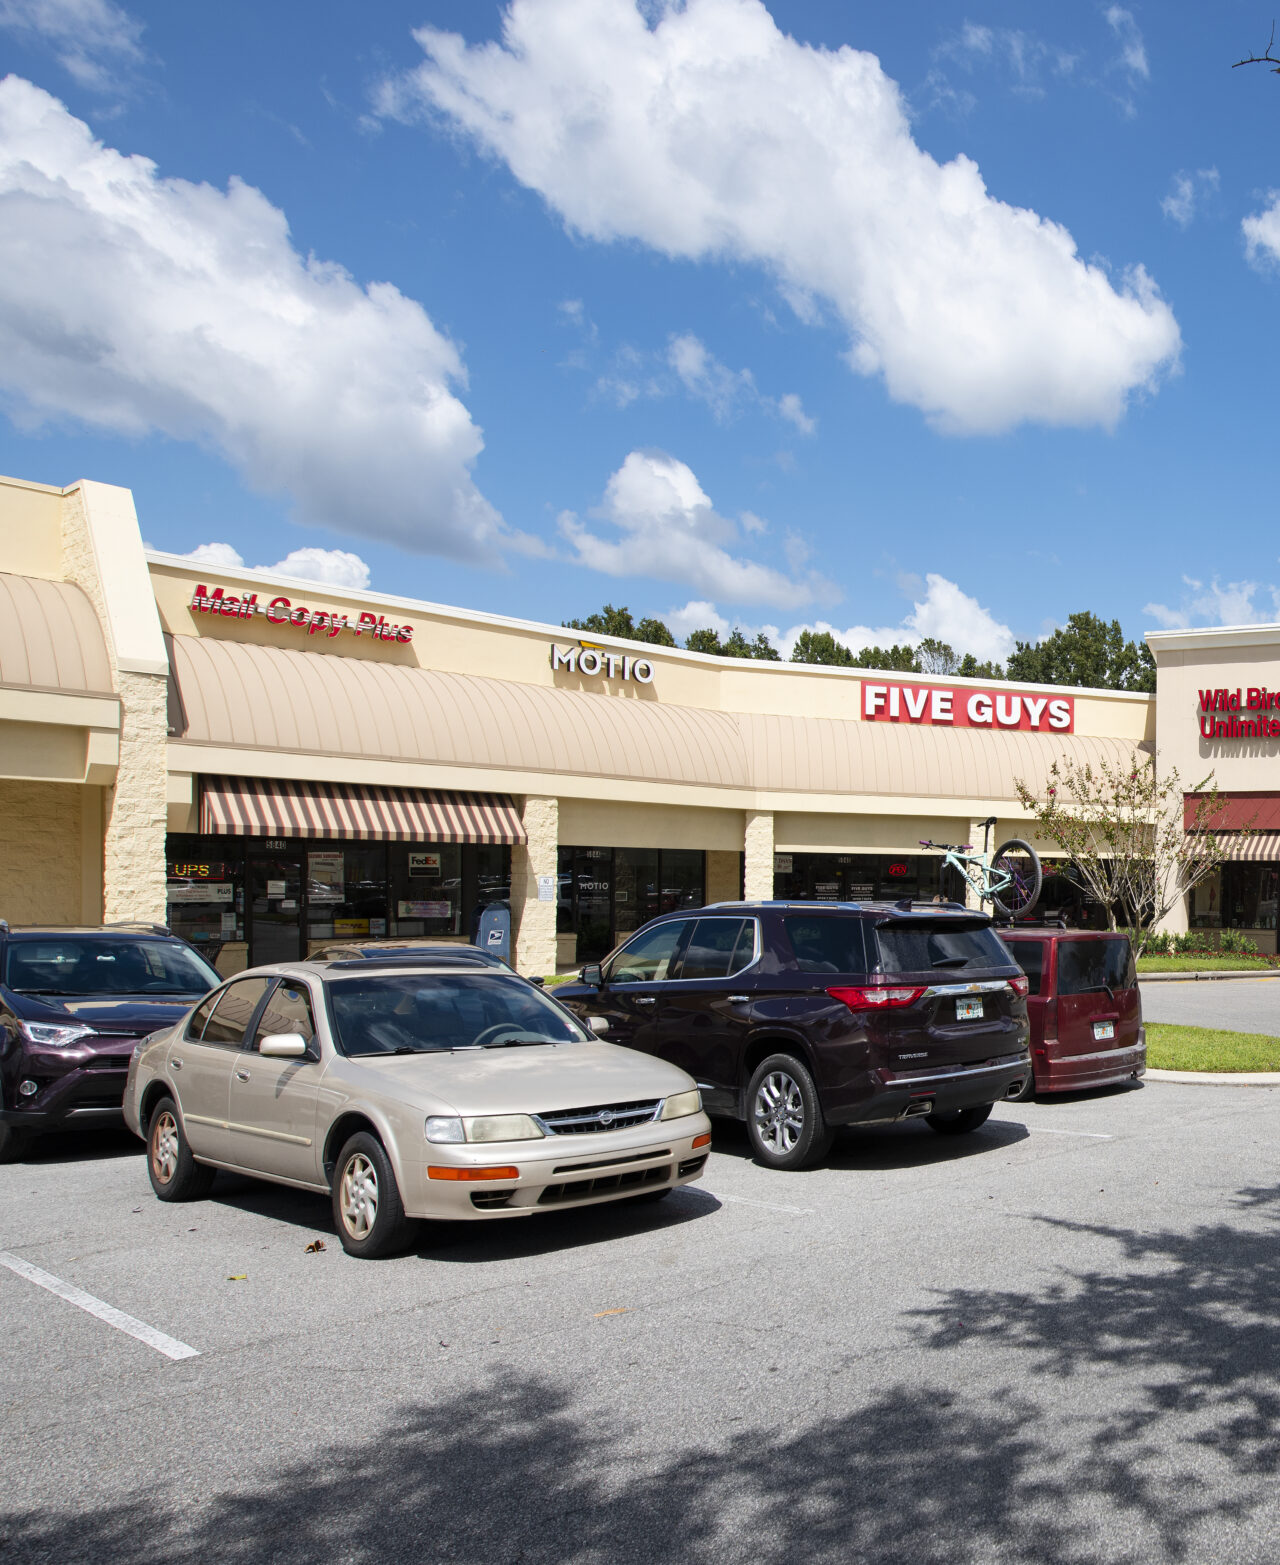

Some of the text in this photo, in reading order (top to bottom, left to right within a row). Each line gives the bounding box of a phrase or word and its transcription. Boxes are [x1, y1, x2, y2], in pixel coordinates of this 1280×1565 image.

[191, 584, 414, 643] Mail Copy Plus
[551, 644, 655, 684] MOTIO
[865, 685, 1071, 729] FIVE GUYS
[1198, 688, 1241, 713] Wild
[175, 864, 210, 876] UPS
[411, 856, 437, 865] FedEx
[579, 882, 609, 890] MOTIO
